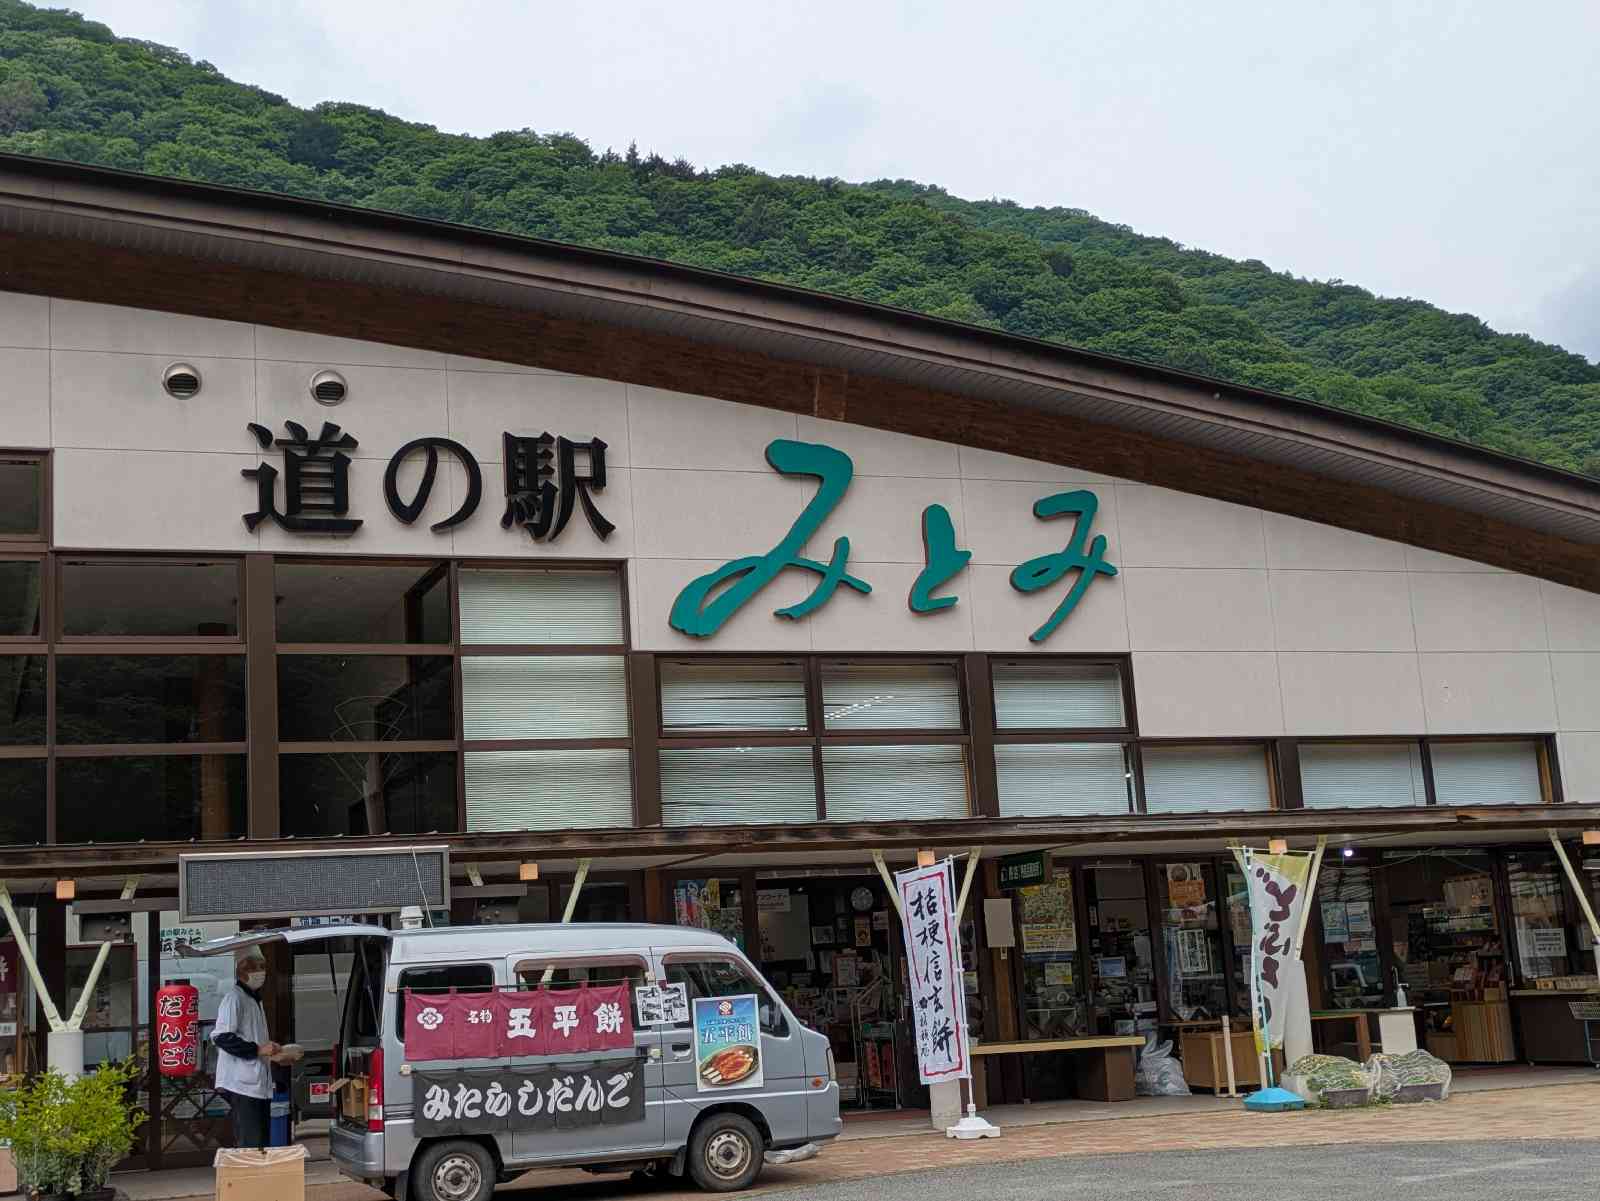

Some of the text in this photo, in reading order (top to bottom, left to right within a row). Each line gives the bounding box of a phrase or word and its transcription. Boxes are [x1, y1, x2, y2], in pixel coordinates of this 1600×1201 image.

[241, 420, 1118, 642] 道の駅 みとみ
[909, 887, 954, 1062] 桔梗信玄餅
[160, 995, 185, 1066] だんご
[466, 1009, 493, 1024] 名物
[507, 1003, 624, 1038] 五平餅
[423, 1071, 634, 1121] みたらしだんご
